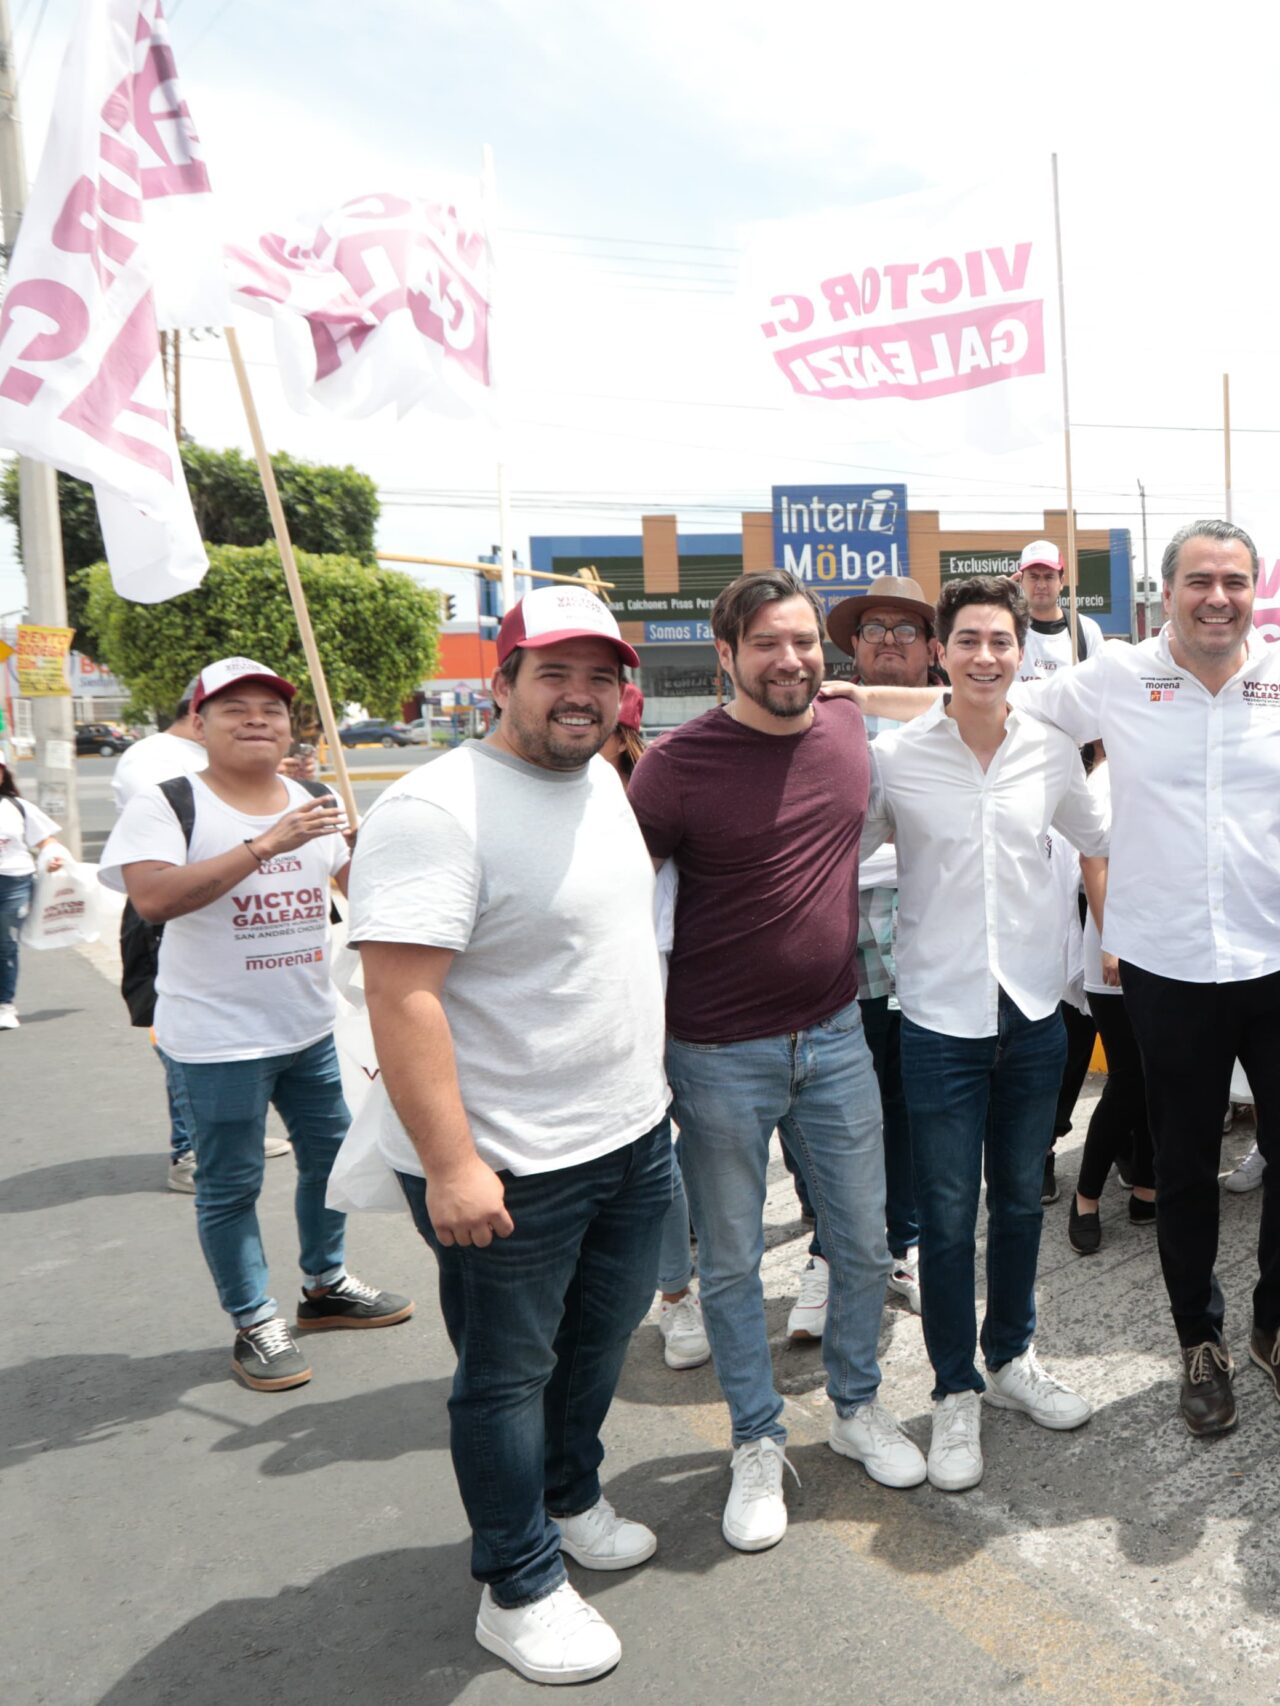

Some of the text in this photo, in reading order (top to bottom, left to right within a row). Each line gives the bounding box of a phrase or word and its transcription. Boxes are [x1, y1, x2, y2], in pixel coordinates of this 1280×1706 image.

[781, 495, 857, 533] Inter
[783, 543, 899, 581] Möbel
[649, 624, 691, 640] Somos
[1145, 682, 1180, 690] morena
[259, 860, 300, 874] VOTA
[231, 886, 323, 912] VICTOR
[232, 904, 325, 927] GALEAZZ
[234, 932, 255, 941] SAN
[257, 927, 296, 939] ANDRÉS
[246, 953, 313, 971] morena
